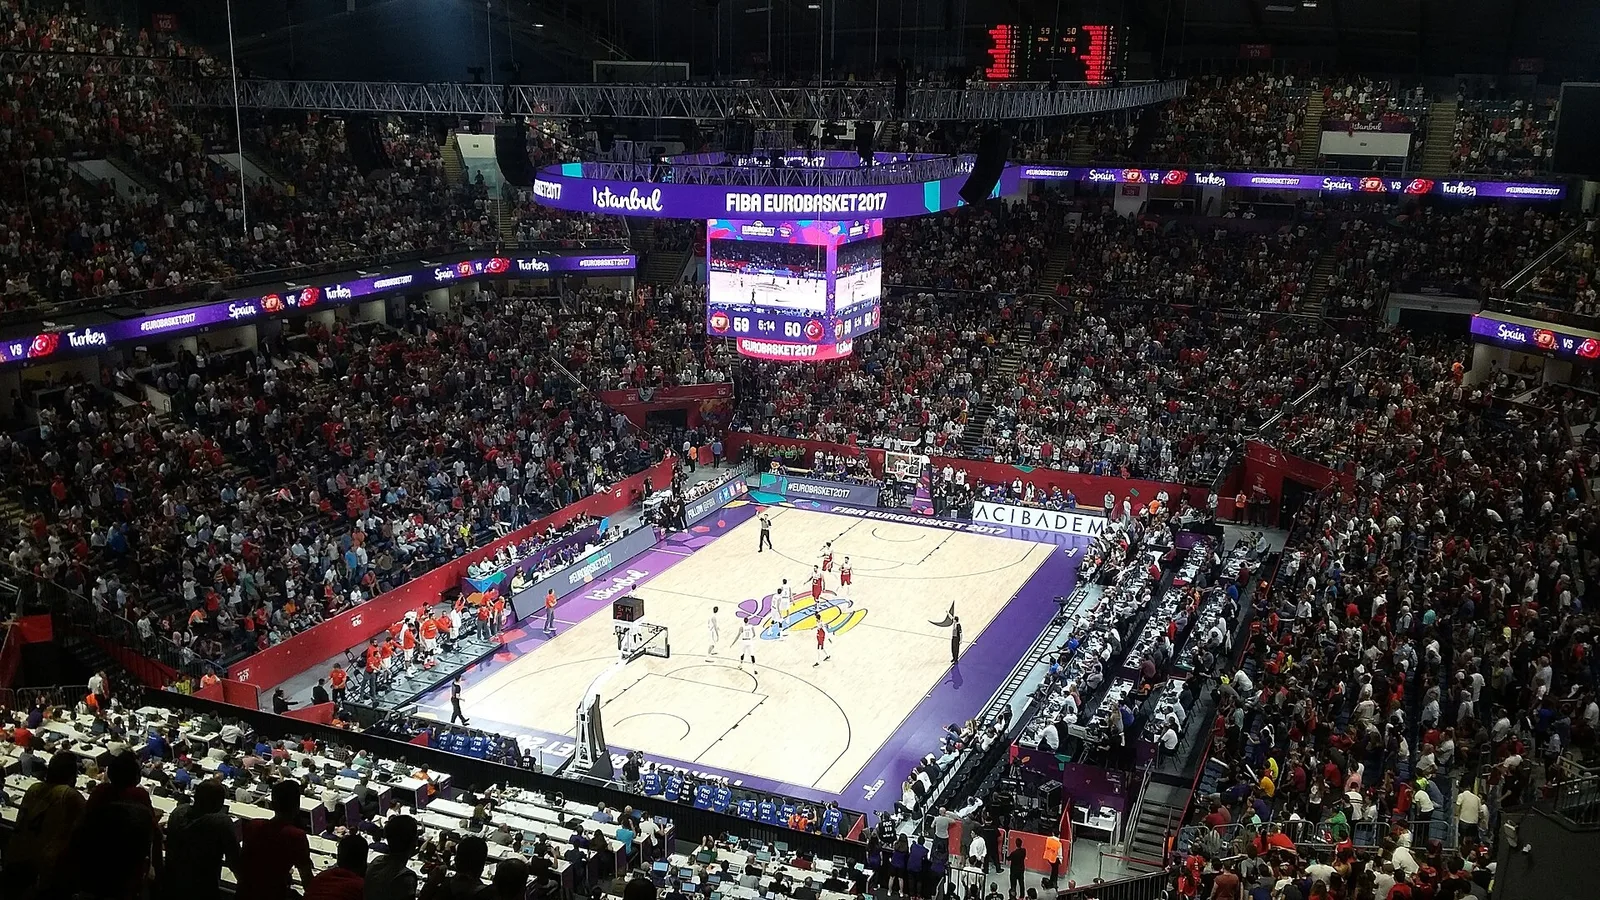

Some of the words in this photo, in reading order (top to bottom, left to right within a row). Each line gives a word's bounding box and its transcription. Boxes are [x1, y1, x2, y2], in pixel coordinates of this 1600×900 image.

[1067, 27, 1077, 35] 50
[1089, 169, 1116, 182] Spain
[1149, 172, 1159, 181] VS
[1194, 173, 1226, 186] Turkey
[1251, 177, 1300, 185] #EUROBASKET2017
[1322, 178, 1353, 193] Spain
[1391, 181, 1402, 190] VS
[1442, 182, 1477, 196] Turkey
[592, 186, 664, 211] Istanbul
[1506, 187, 1561, 196] #EUROBASKET2017
[726, 192, 762, 212] FIBA
[434, 267, 455, 280] Spain
[517, 258, 549, 271] Turkey
[579, 258, 630, 267] #EUROBASKET2017
[228, 301, 257, 319] Spain
[286, 294, 296, 305] VS
[324, 285, 351, 299] Turkey
[141, 313, 196, 331] #EUROBASKET2017
[10, 343, 23, 356] VS
[67, 328, 106, 347] Turkey
[1497, 324, 1527, 342] Spain
[1562, 338, 1574, 349] VS
[741, 339, 818, 356] #EUROBASKET2017
[787, 482, 851, 498] #EUROBASKET2017
[831, 506, 866, 516] FIBA
[866, 510, 969, 530] EUROBASKET
[966, 526, 1008, 535] 2017
[975, 504, 1105, 535] ACIBADEM
[568, 553, 612, 584] #EUROBASKET2017
[584, 569, 649, 600] Istanbul
